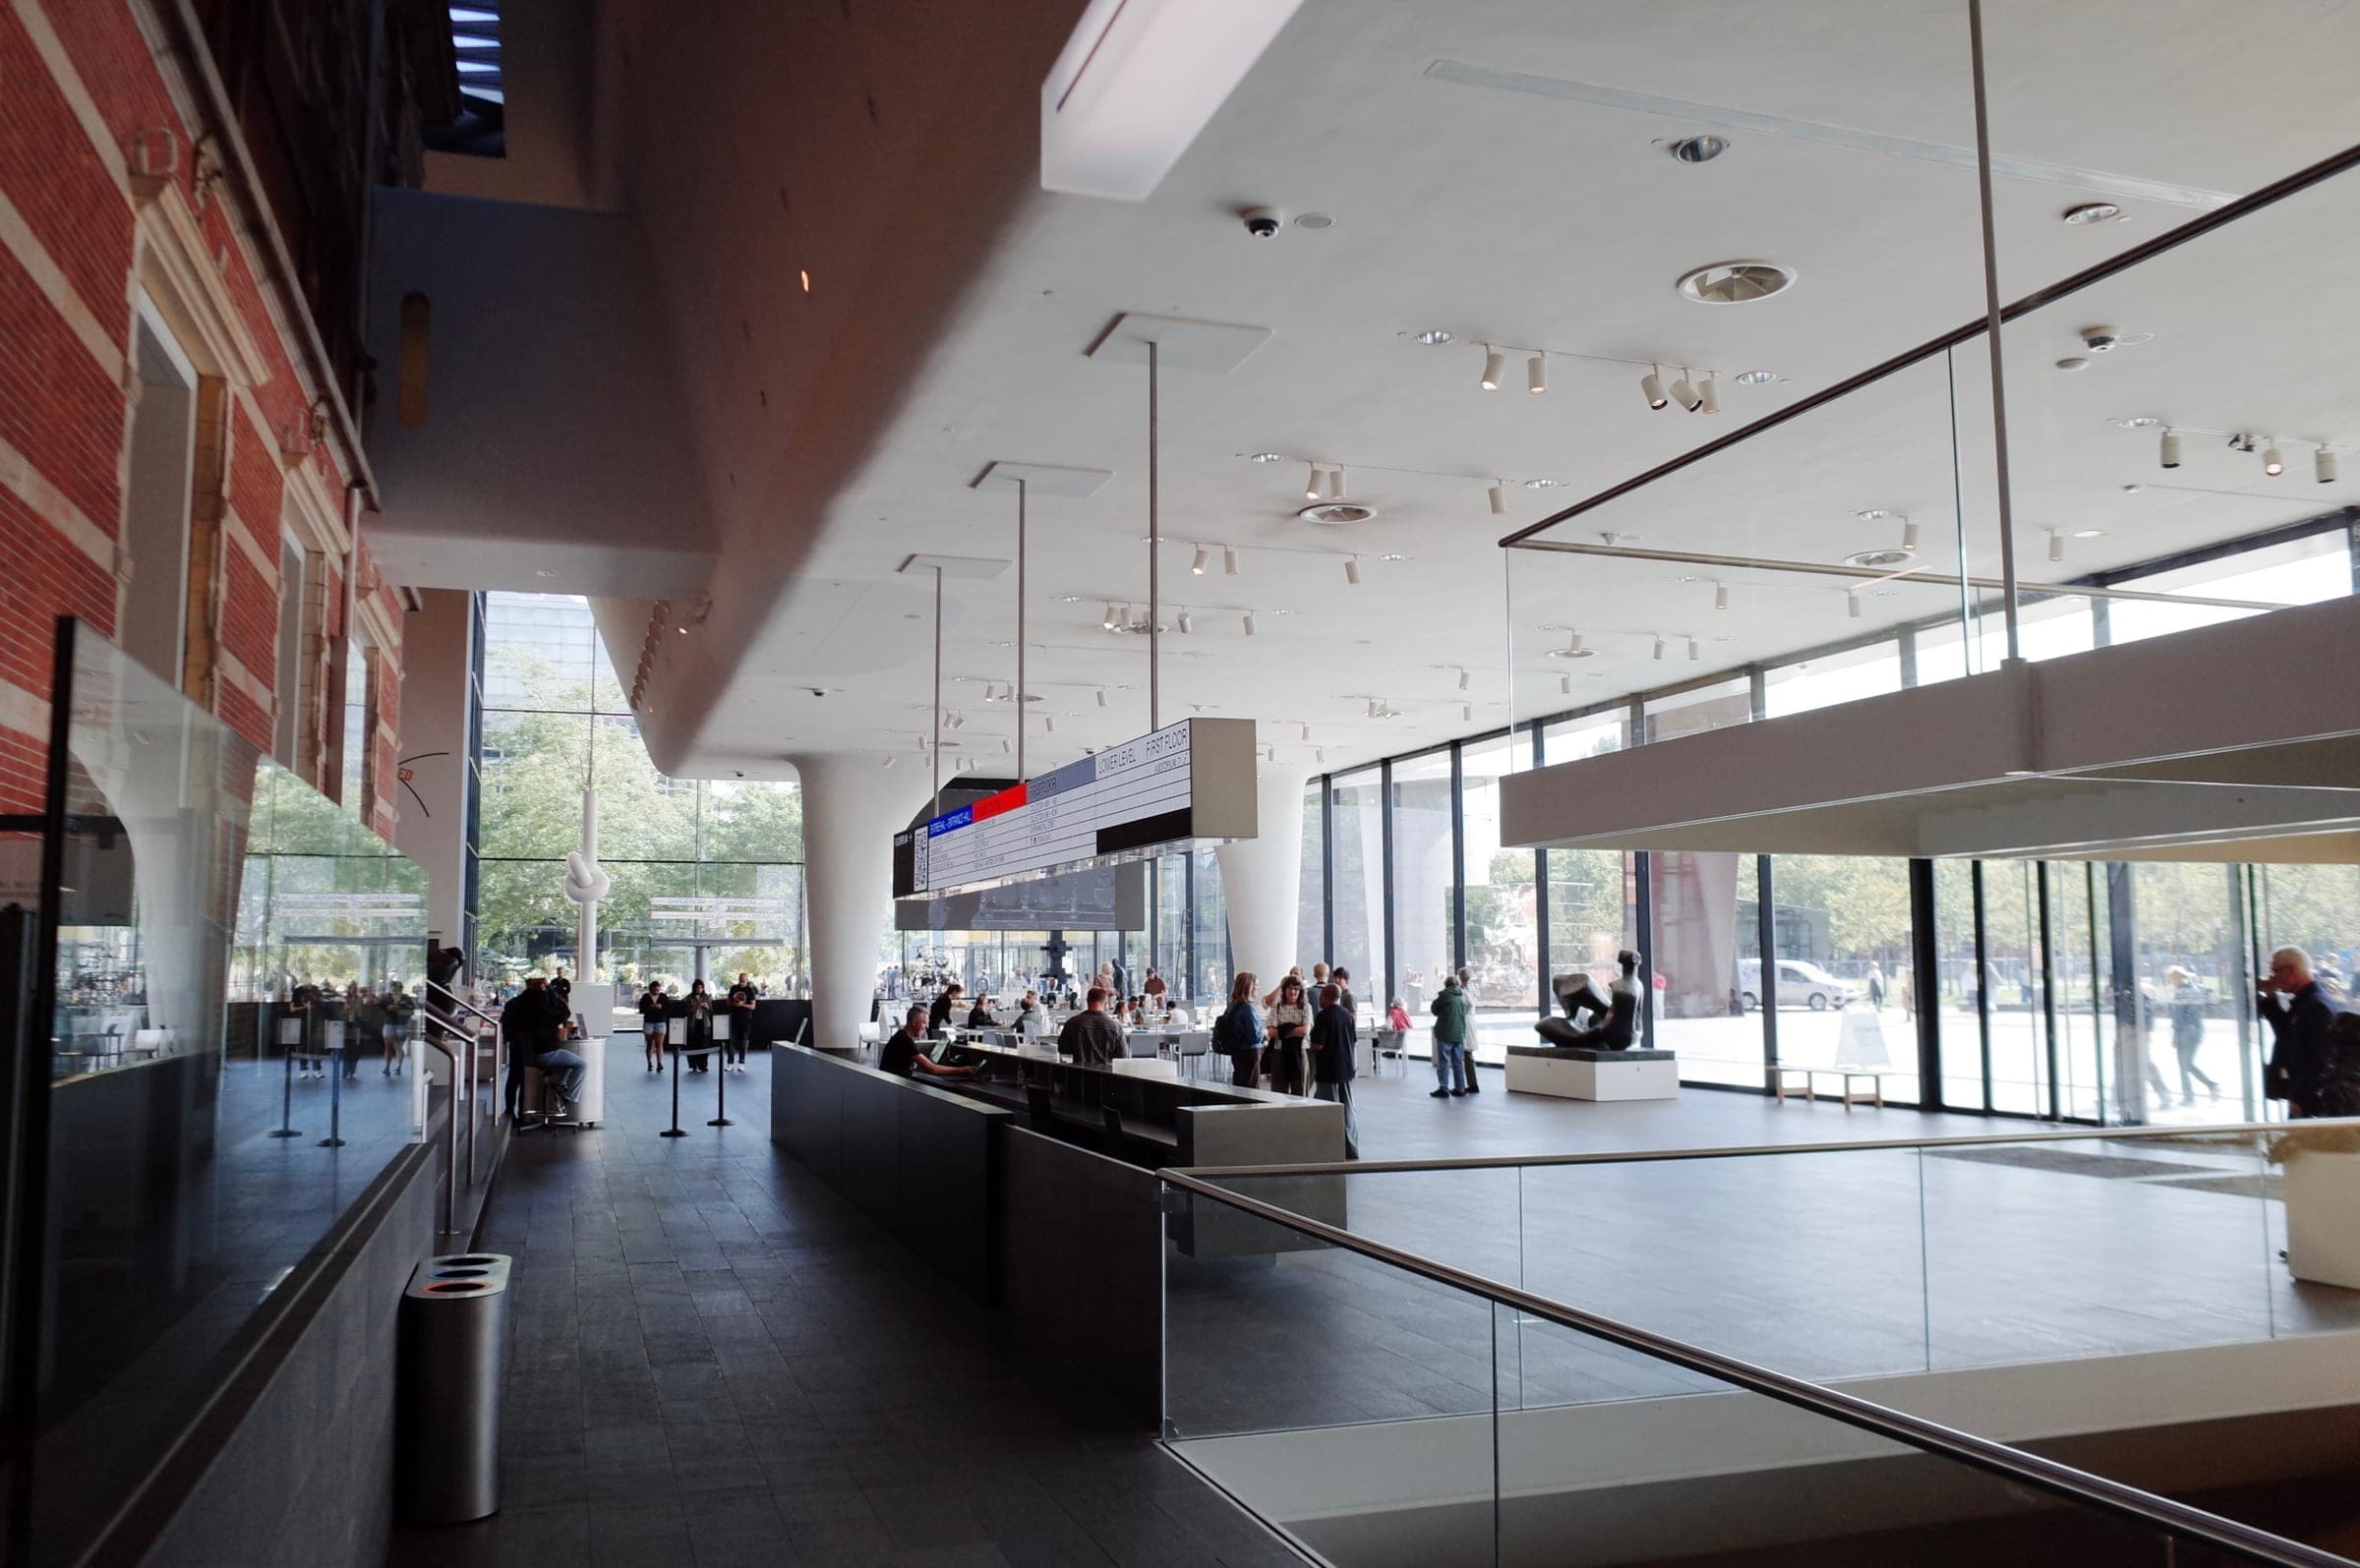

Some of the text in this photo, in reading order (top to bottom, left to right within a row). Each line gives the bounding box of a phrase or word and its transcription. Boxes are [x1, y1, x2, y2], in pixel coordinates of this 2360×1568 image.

[1165, 727, 1188, 749] FLOOR
[1098, 748, 1137, 775] LOWER LEVEL
